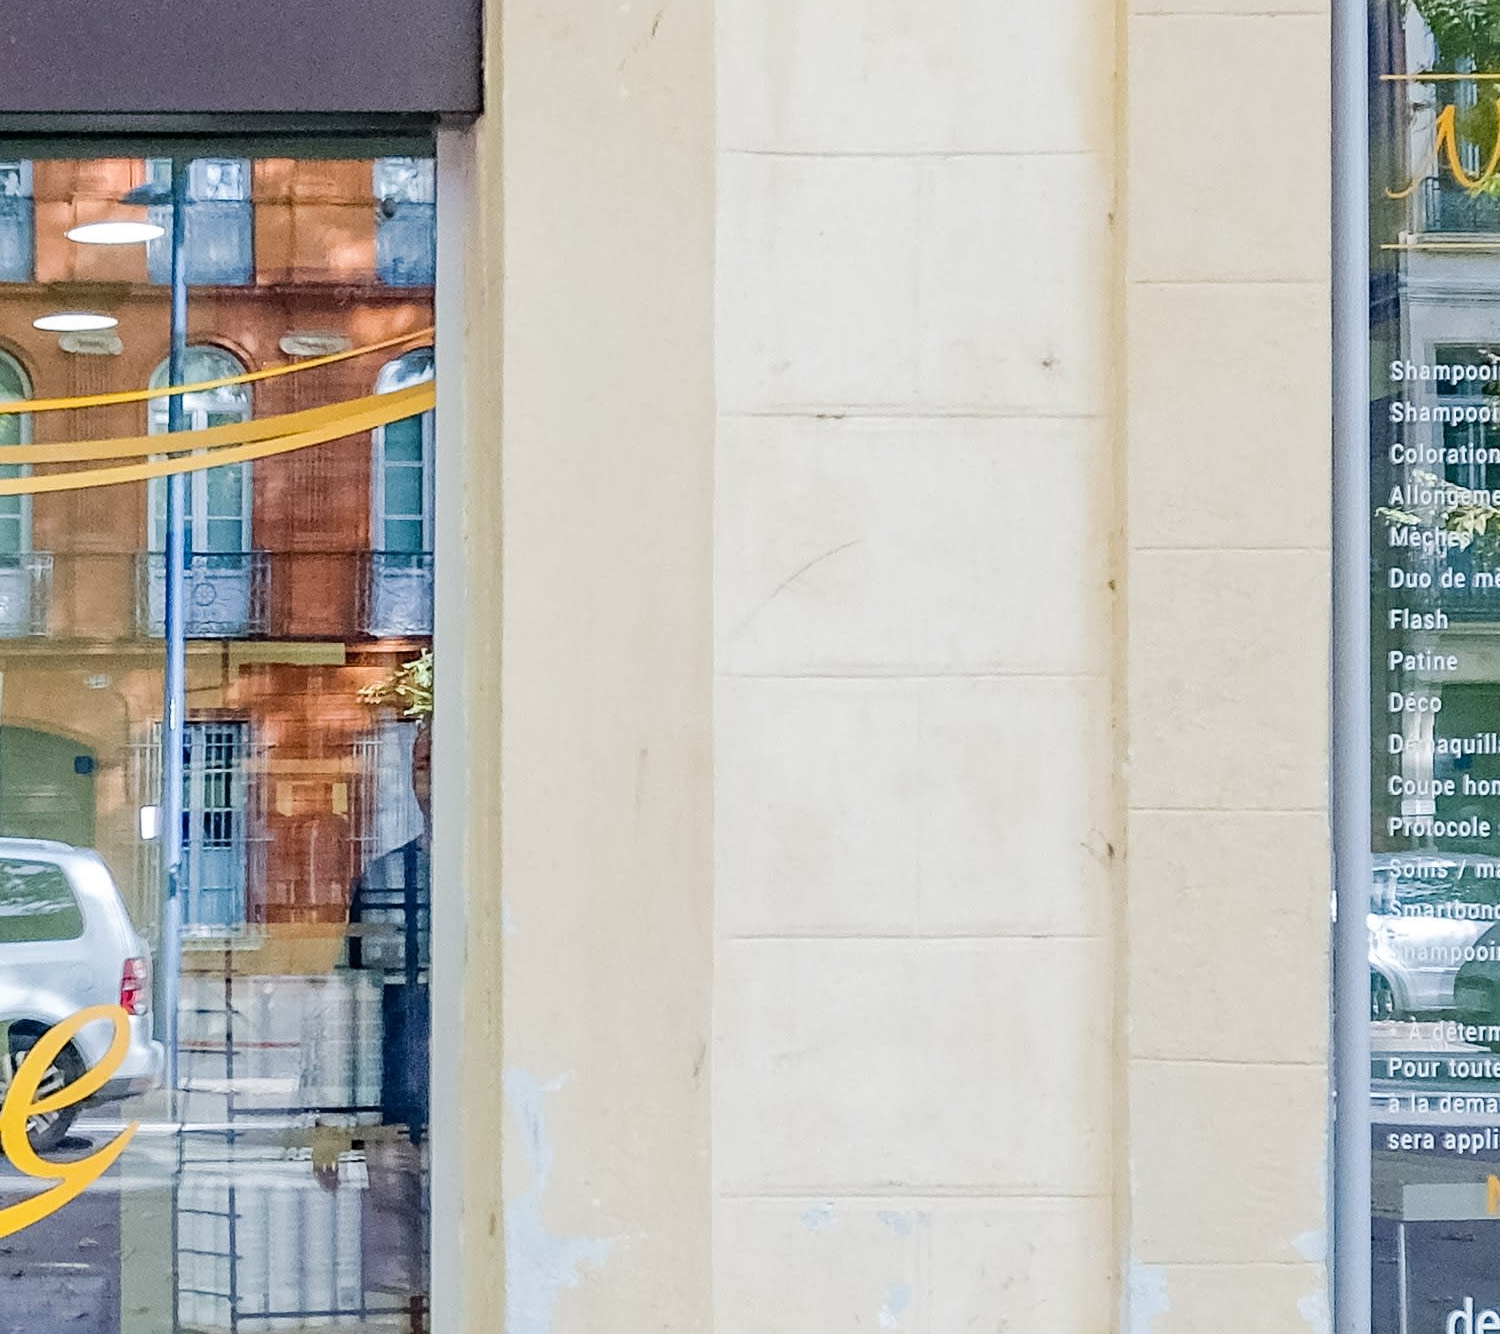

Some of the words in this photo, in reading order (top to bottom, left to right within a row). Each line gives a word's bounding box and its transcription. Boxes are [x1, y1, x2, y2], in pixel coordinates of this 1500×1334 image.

[1389, 443, 1499, 465] Coloration
[1388, 568, 1432, 588] Duo
[1440, 567, 1466, 588] de
[1388, 608, 1449, 630] Flash
[1389, 650, 1459, 673] Patine
[1389, 691, 1443, 715] Déco
[1388, 774, 1458, 800] Coupe
[1388, 816, 1491, 839] Protocole
[1388, 1059, 1440, 1080] Pour
[1411, 1094, 1430, 1115] la
[1387, 1134, 1435, 1151] sera
